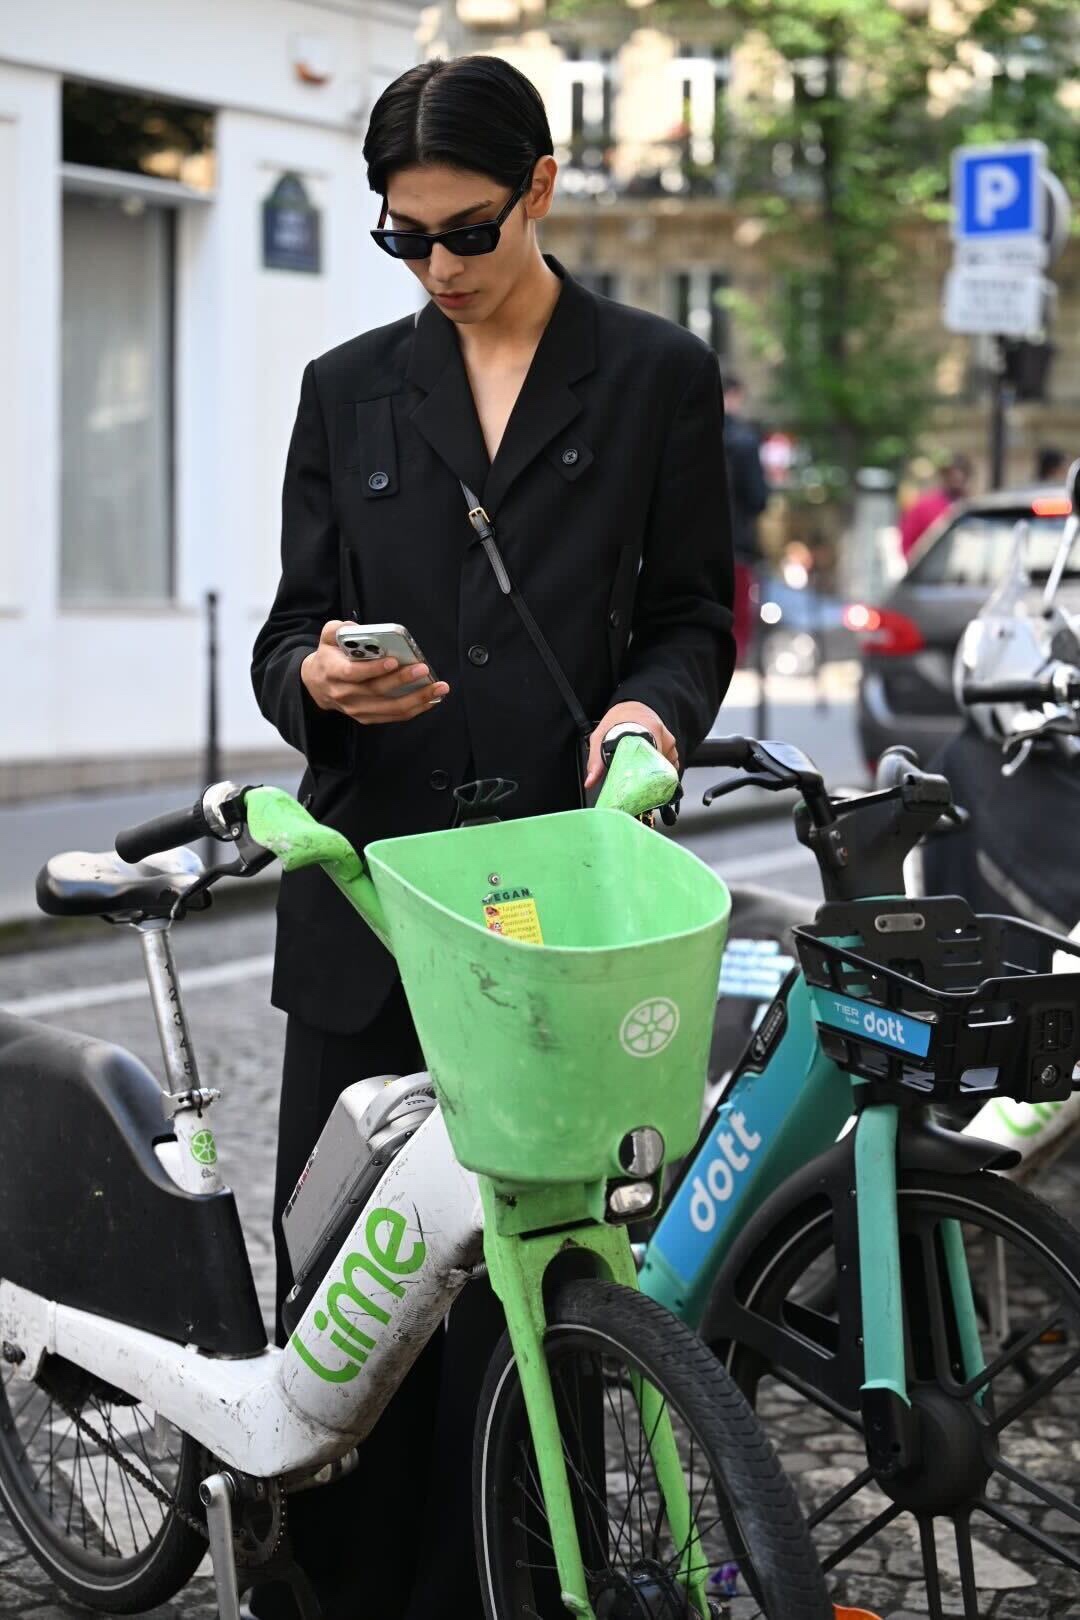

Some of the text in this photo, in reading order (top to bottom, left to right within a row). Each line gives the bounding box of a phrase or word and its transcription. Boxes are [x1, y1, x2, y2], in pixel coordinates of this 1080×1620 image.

[975, 163, 1020, 227] P
[169, 987, 178, 1002] 2
[174, 1012, 182, 1027] 3
[834, 1002, 860, 1018] TIER
[863, 1011, 905, 1044] dott
[180, 1038, 190, 1049] 4
[184, 1061, 193, 1076] 5
[690, 1111, 762, 1233] dott
[291, 1206, 427, 1384] Lime
